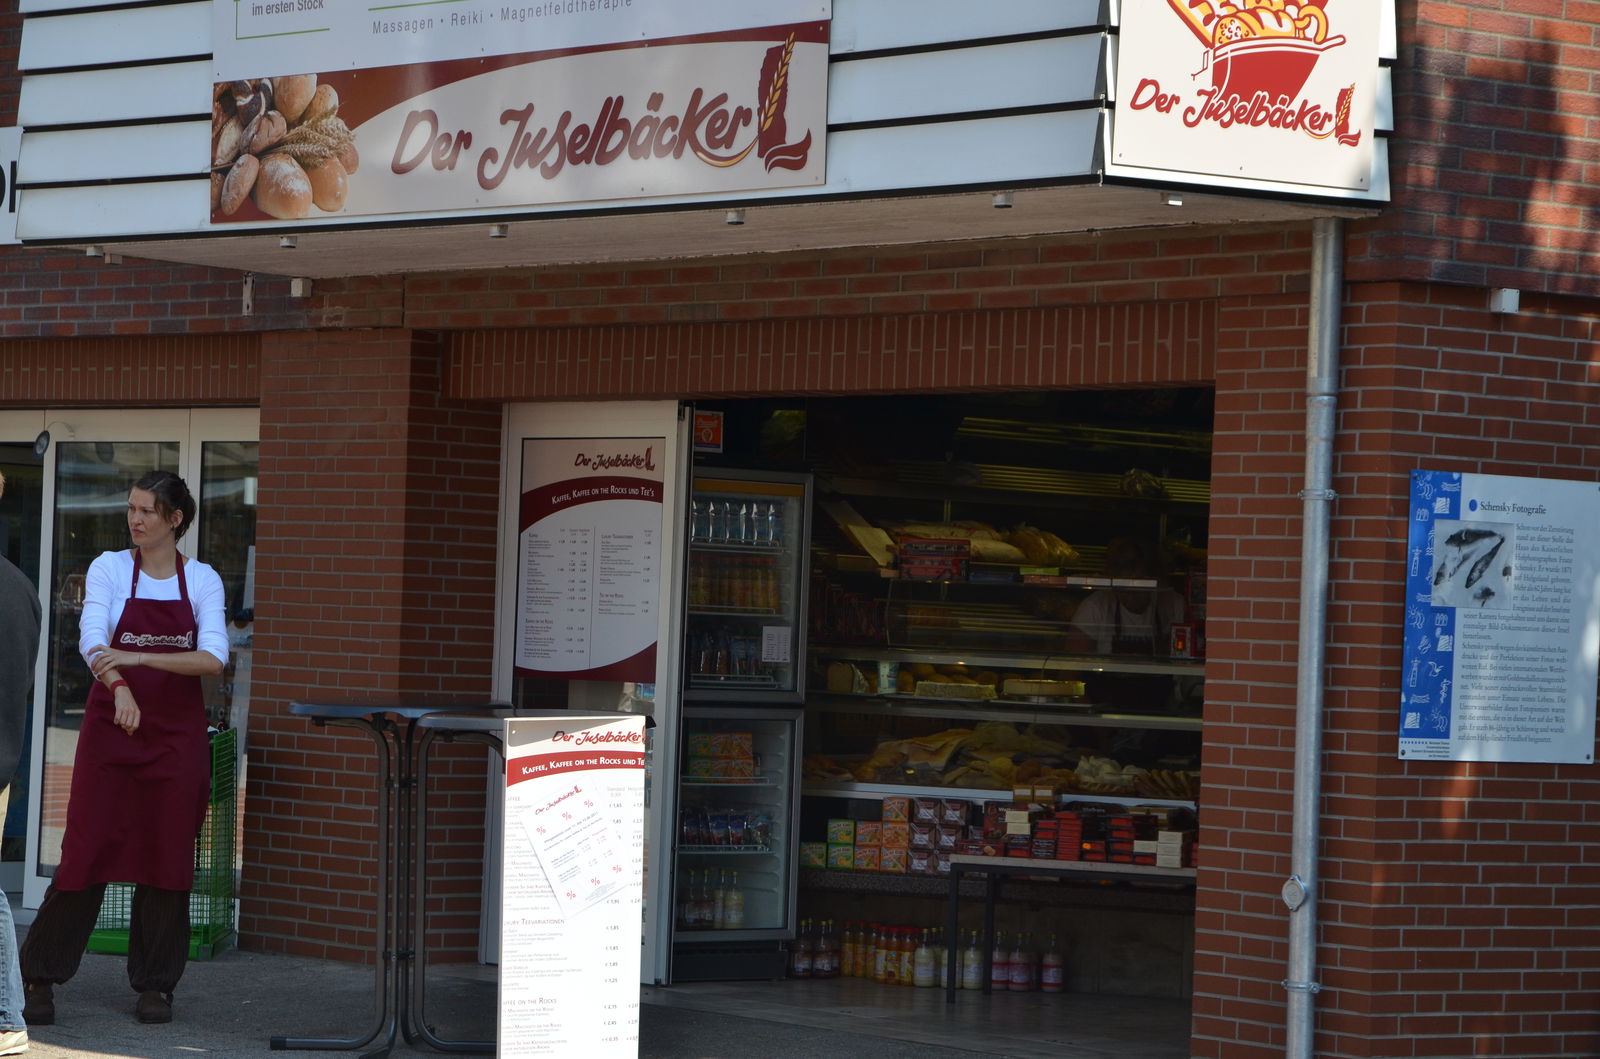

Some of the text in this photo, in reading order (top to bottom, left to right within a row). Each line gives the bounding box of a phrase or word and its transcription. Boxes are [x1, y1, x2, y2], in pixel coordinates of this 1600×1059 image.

[252, 0, 325, 17] im ersten Stock
[372, 0, 633, 35] Massagen Reiki Magnetfeldtherapie
[1130, 77, 1181, 114] Der
[390, 108, 473, 176] Der
[574, 453, 591, 467] Der
[1480, 501, 1547, 517] Schensky Fotografie
[120, 631, 138, 645] Der
[551, 730, 574, 743] Der
[521, 763, 548, 775] KAFFEE,
[549, 760, 573, 771] KAFFEE
[599, 756, 621, 766] ROCKS
